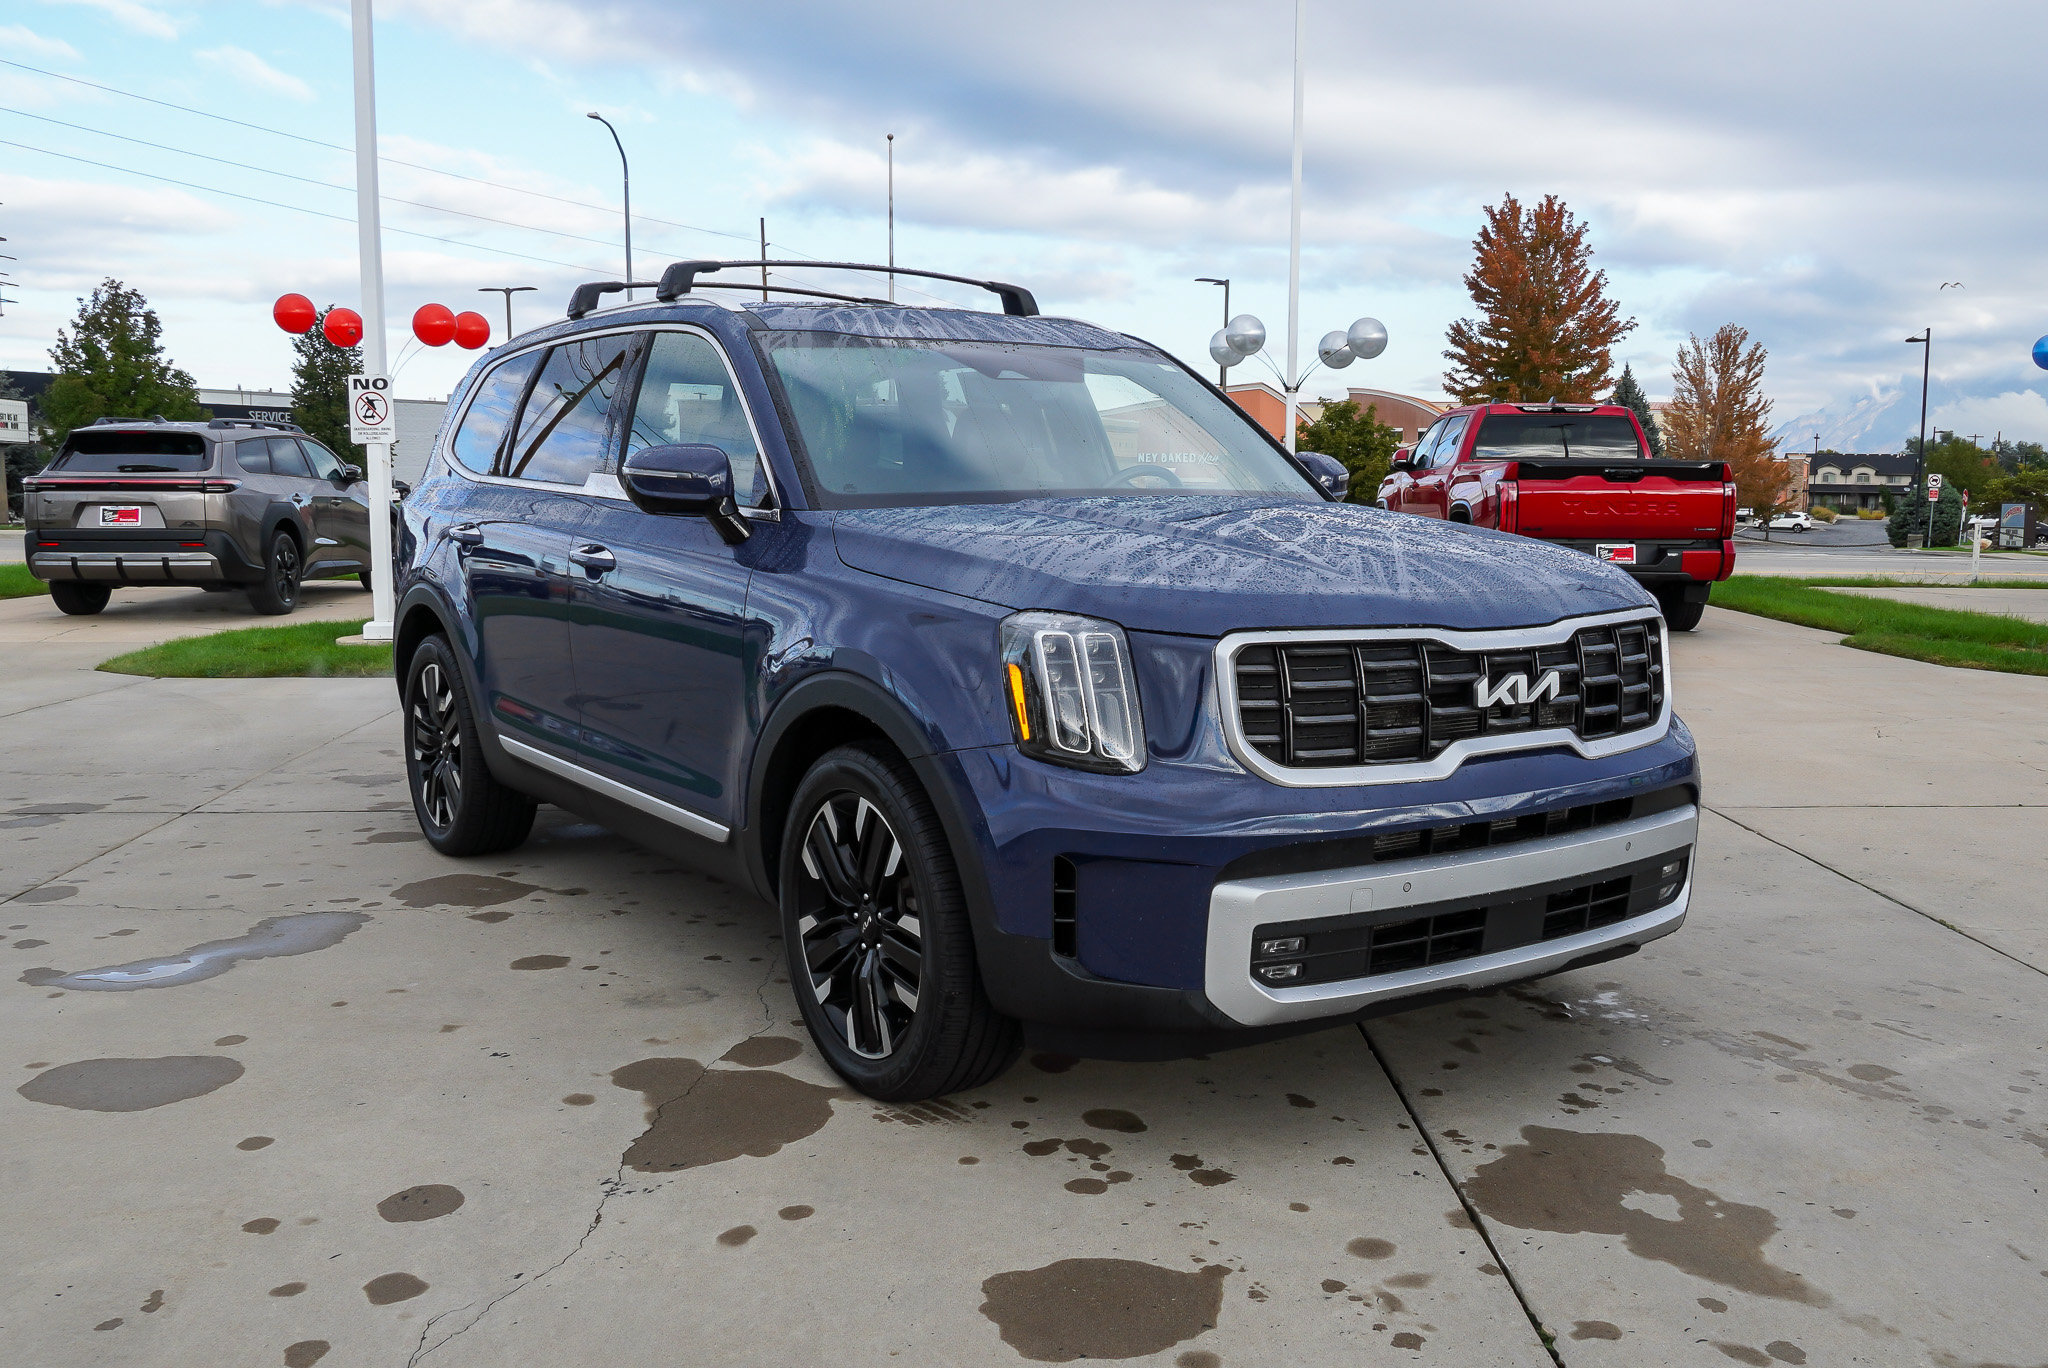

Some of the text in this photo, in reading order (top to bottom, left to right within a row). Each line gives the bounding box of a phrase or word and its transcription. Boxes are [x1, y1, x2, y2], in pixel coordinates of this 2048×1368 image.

[353, 378, 388, 390] NO
[248, 410, 292, 422] SERVICE
[1138, 453, 1158, 463] NEY
[1161, 453, 1197, 463] BAKED
[1562, 500, 1681, 516] TUNDRA
[1476, 670, 1560, 708] KIA
